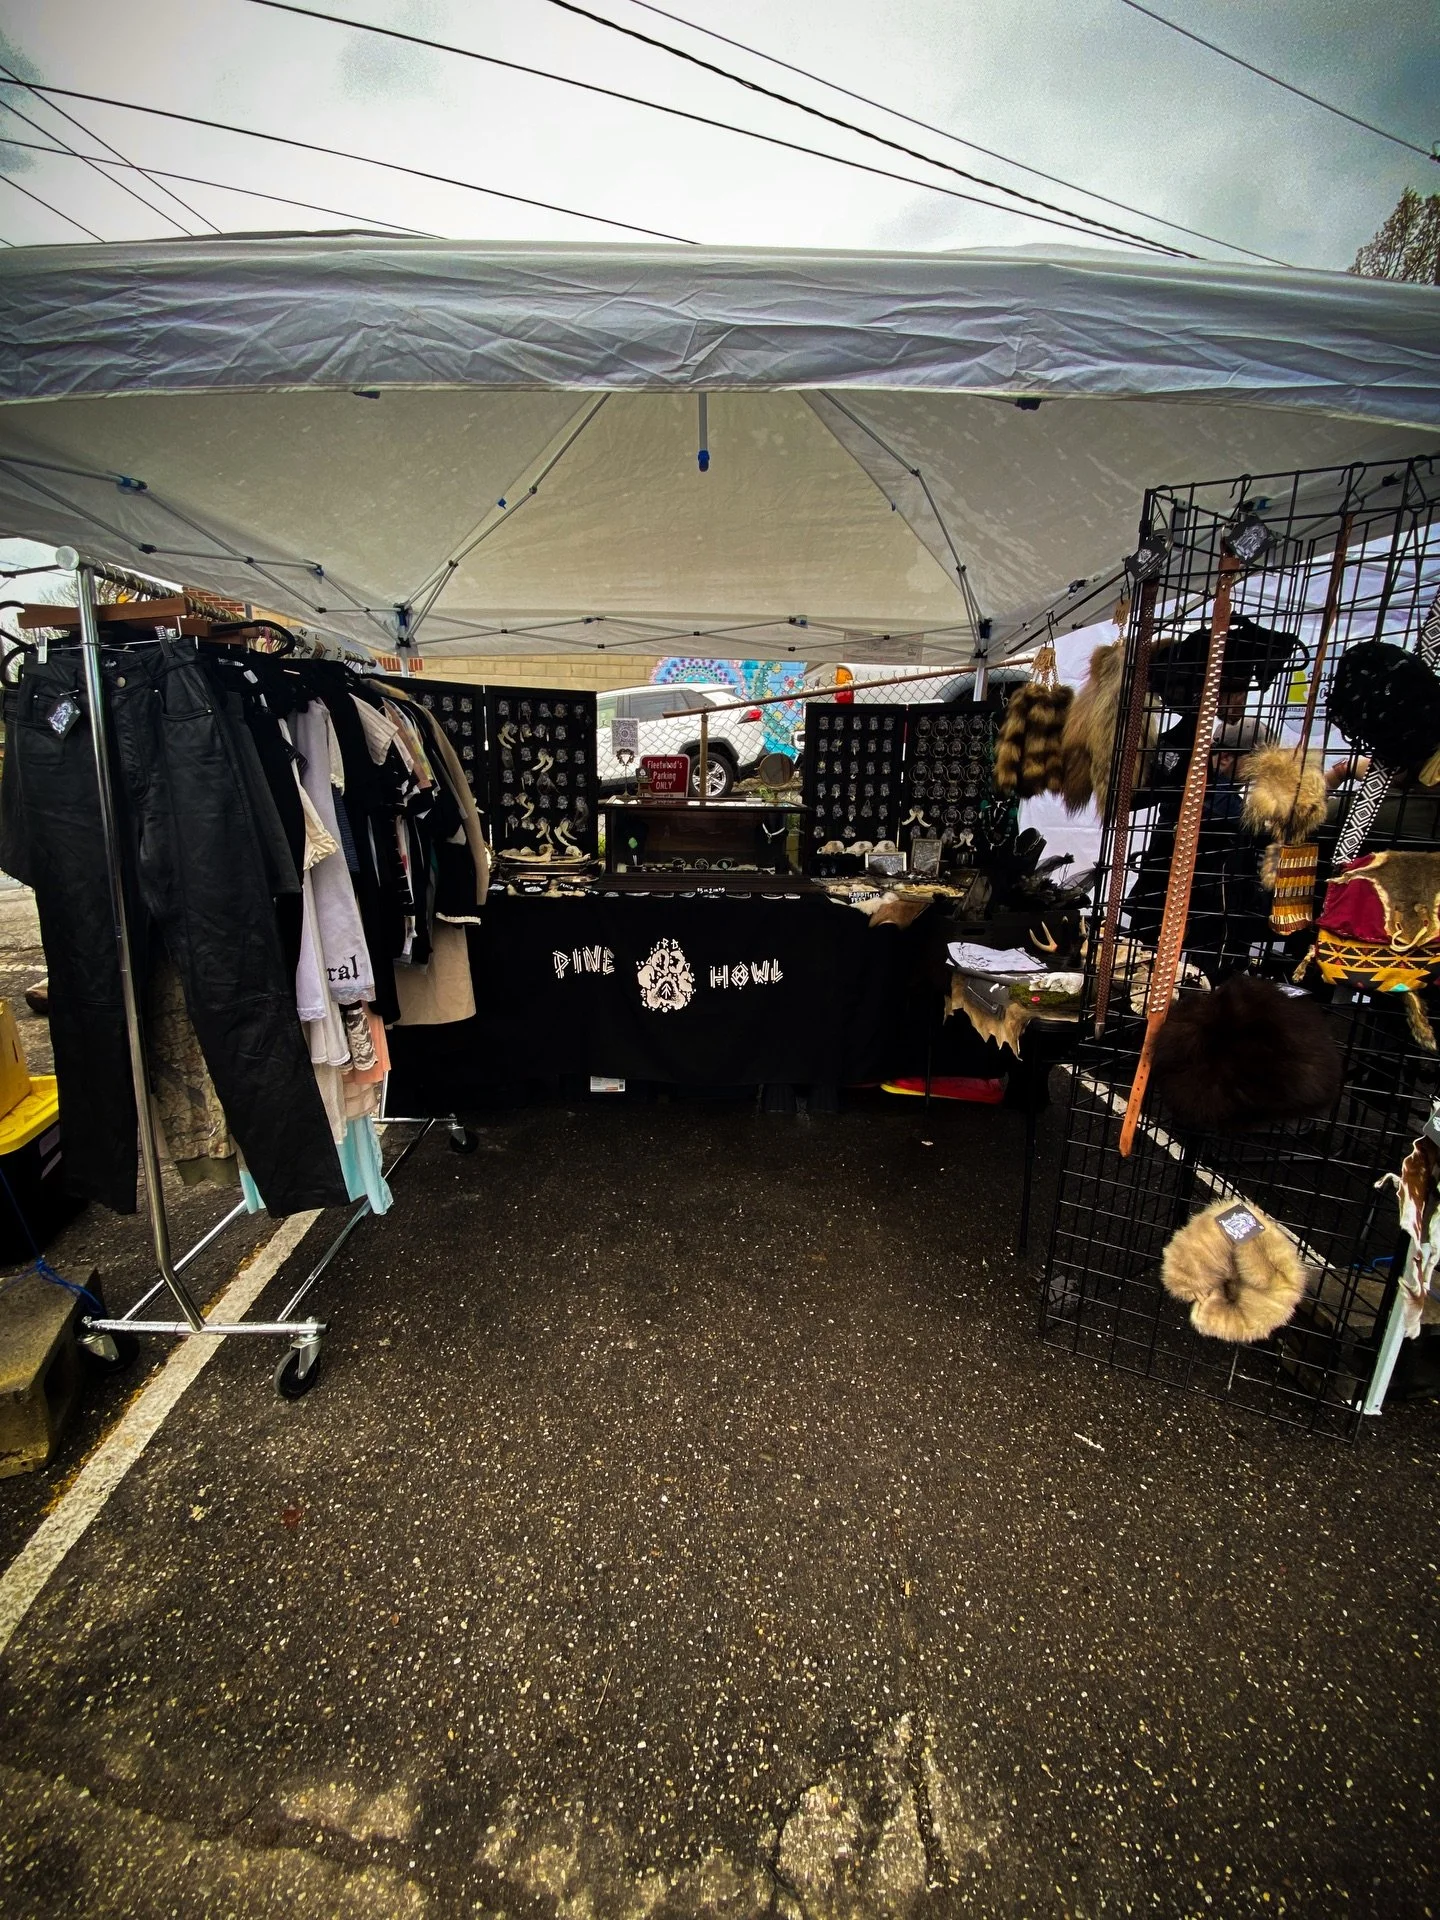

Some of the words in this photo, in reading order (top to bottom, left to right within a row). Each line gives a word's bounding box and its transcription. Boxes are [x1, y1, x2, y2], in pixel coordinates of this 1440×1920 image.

[299, 628, 308, 637] M
[647, 760, 683, 769] Fleetwood's
[653, 771, 677, 782] Parking
[655, 781, 673, 790] ONLY
[552, 945, 615, 979] PINE
[709, 958, 784, 990] HOWL
